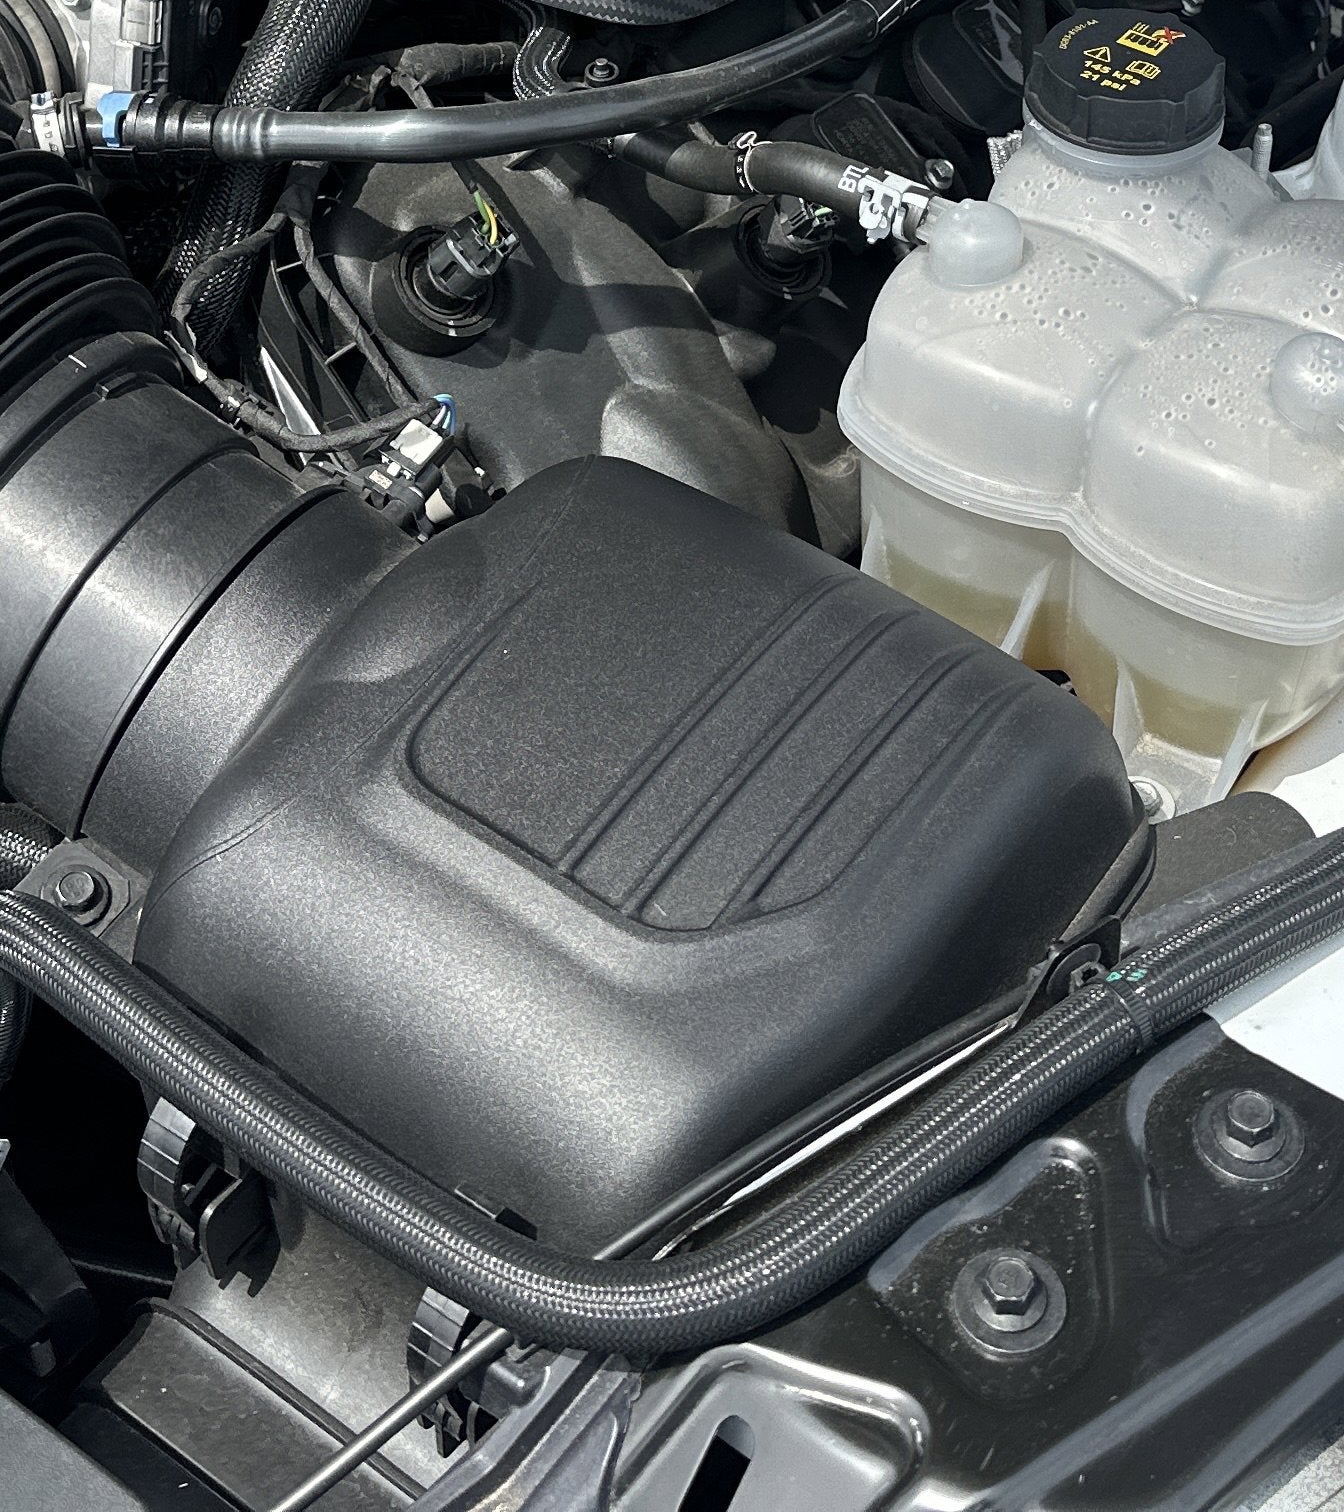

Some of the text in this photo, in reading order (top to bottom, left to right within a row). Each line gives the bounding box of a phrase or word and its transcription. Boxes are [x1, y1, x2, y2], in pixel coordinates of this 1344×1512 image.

[1079, 70, 1101, 82] 21
[1084, 60, 1141, 86] 145 kPa
